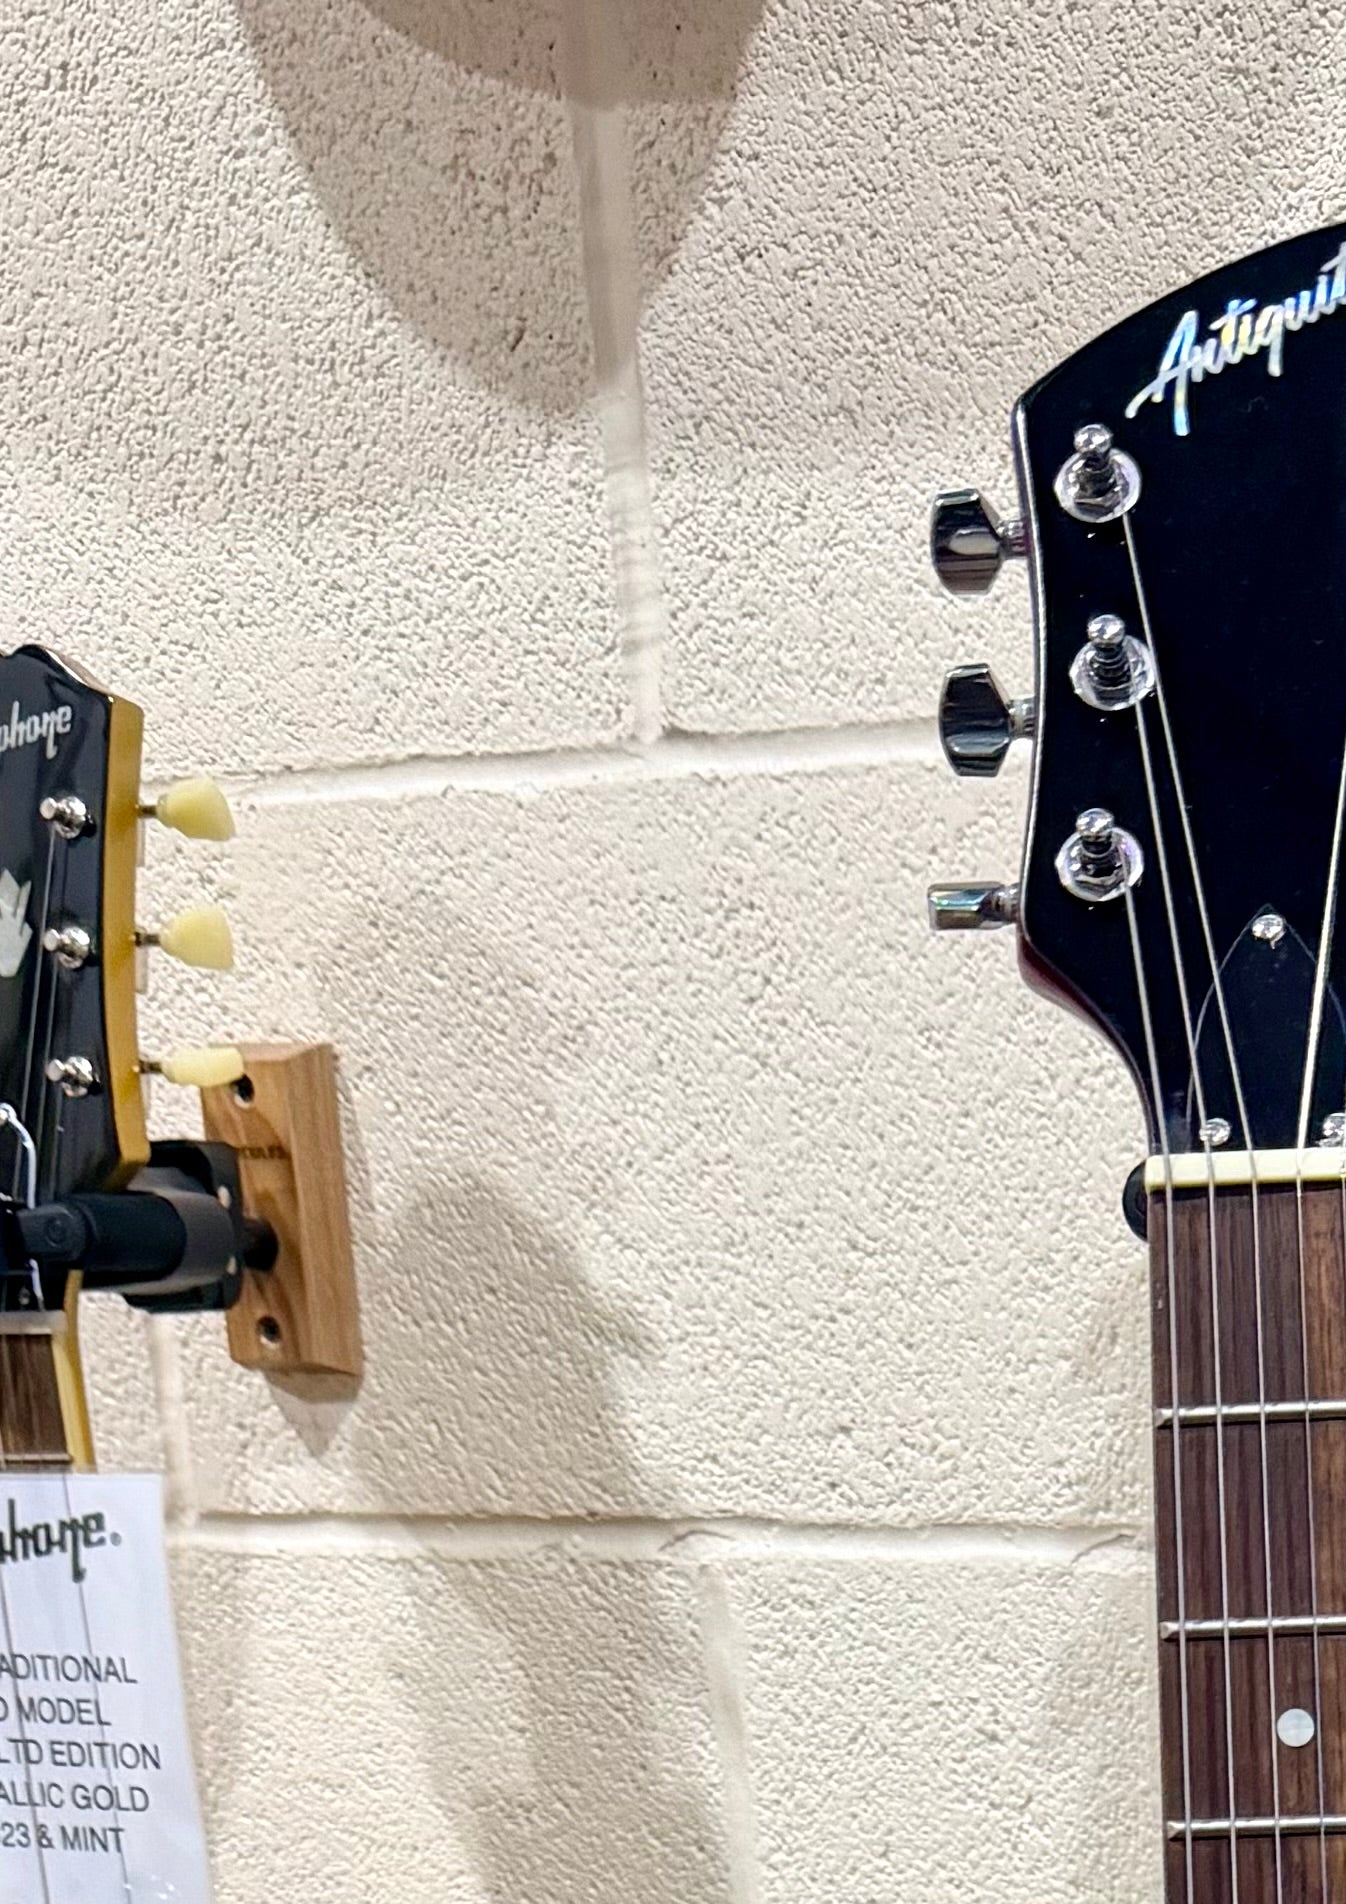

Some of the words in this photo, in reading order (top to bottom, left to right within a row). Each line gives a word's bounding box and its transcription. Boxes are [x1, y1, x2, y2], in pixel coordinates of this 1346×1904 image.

[17, 1697, 112, 1726] MODEL
[48, 1741, 161, 1769] EDITION
[71, 1784, 149, 1812] GOLD
[60, 1825, 124, 1853] MINT
